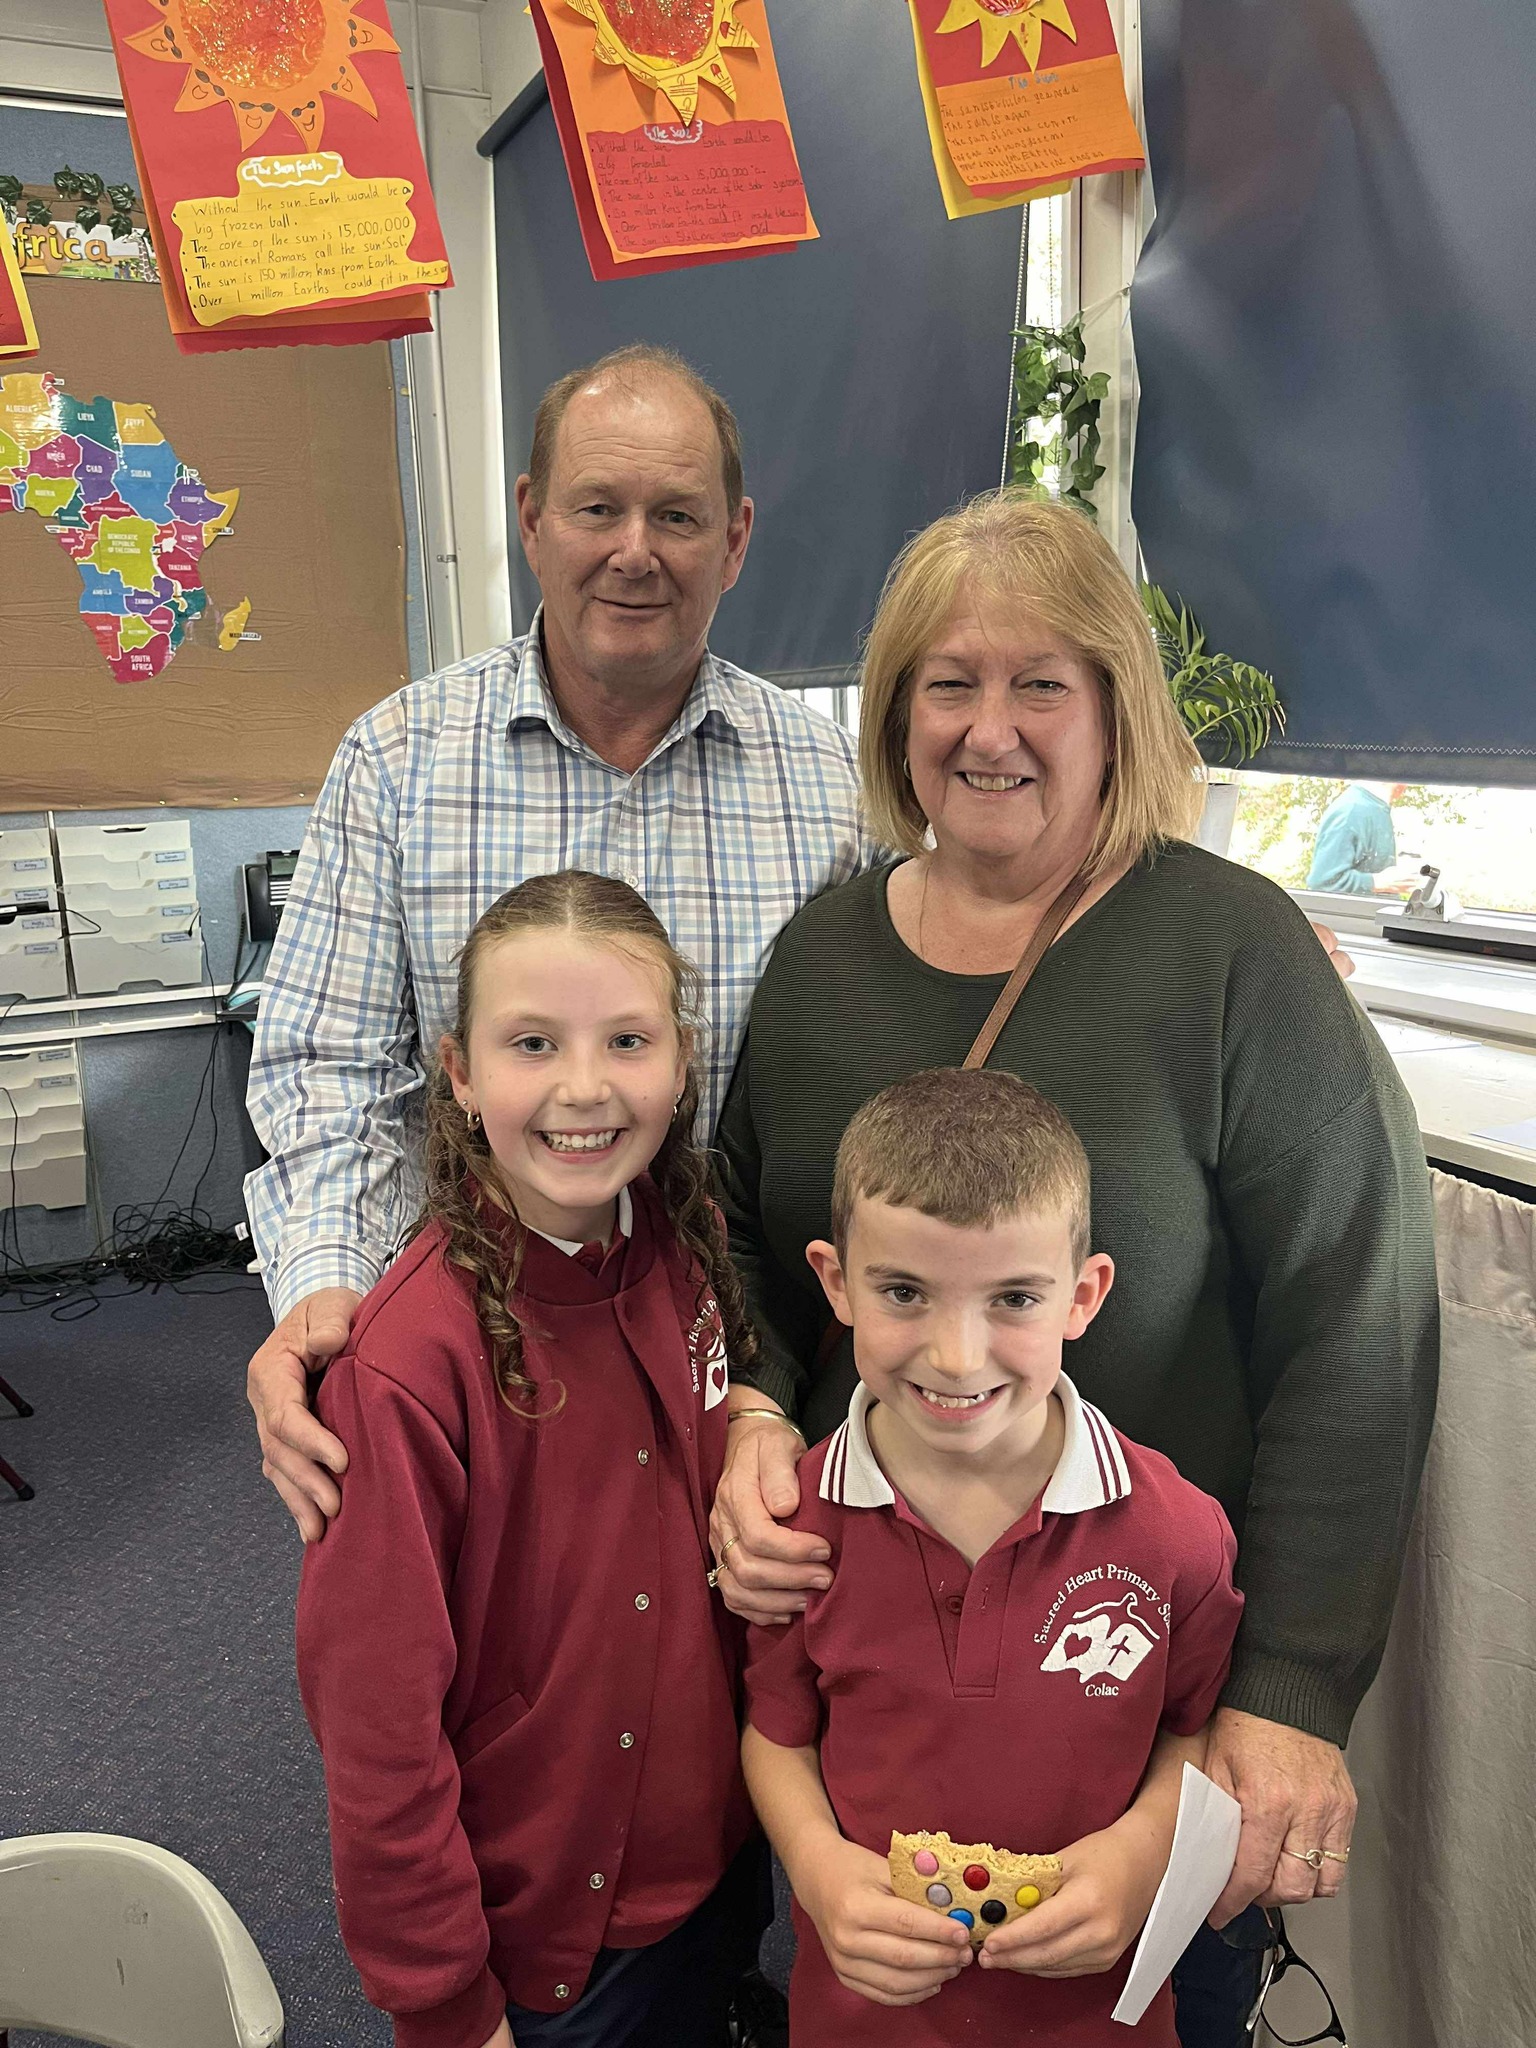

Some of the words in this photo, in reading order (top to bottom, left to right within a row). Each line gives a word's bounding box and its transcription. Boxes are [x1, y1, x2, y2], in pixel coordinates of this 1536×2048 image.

[256, 198, 273, 211] the
[309, 191, 341, 206] Earth
[347, 186, 379, 202] would
[387, 183, 398, 196] be
[402, 186, 411, 195] a
[189, 239, 208, 254] The
[219, 240, 243, 251] core
[253, 238, 264, 253] of
[271, 233, 289, 246] the
[296, 235, 318, 244] sun
[322, 230, 332, 241] is
[194, 221, 214, 240] big
[222, 218, 263, 238] frozen
[13, 222, 111, 269] frica
[196, 256, 216, 270] The
[220, 252, 261, 269] ancient
[268, 250, 307, 264] Romans
[315, 244, 332, 259] call
[341, 241, 355, 255] the
[364, 242, 381, 253] sun
[193, 275, 211, 289] The
[218, 277, 237, 287] sun
[243, 273, 253, 283] is
[259, 268, 276, 282] 150
[279, 266, 312, 280] million
[315, 264, 336, 277] kms
[341, 262, 364, 279] from
[199, 293, 223, 308] Over
[251, 287, 283, 300] million
[294, 281, 329, 296] Earths
[344, 276, 372, 290] could
[380, 274, 393, 289] fit
[398, 272, 408, 282] in
[131, 655, 150, 663] SOUTH
[132, 663, 153, 671] AFRICA
[1033, 1591, 1066, 1644] Sacred
[1064, 1566, 1104, 1595] Heart
[1106, 1563, 1161, 1602] Primary
[1085, 1683, 1119, 1697] Colac
